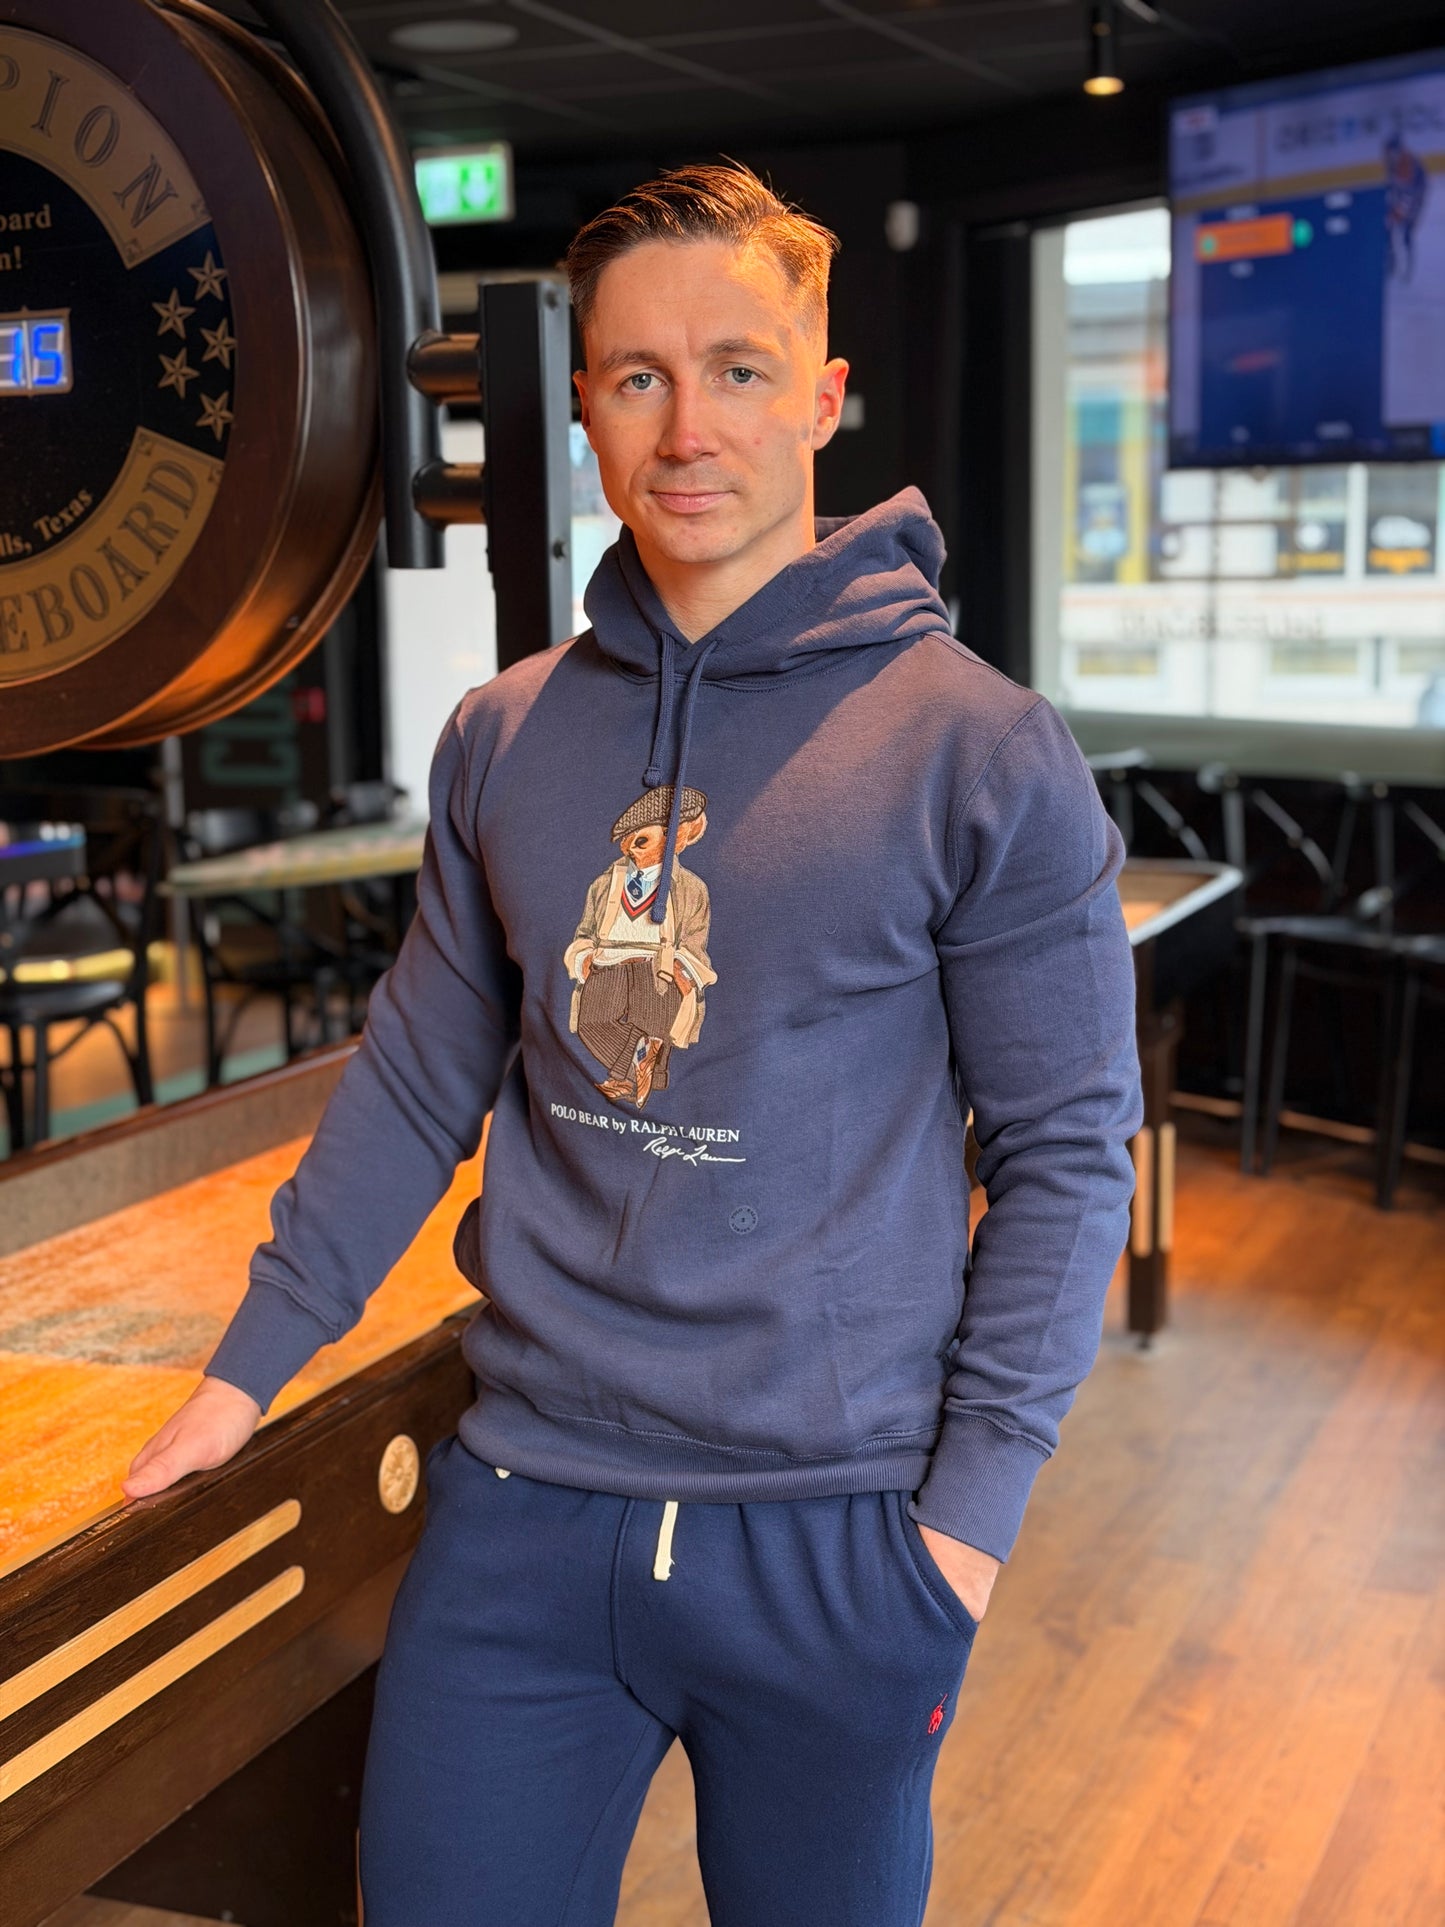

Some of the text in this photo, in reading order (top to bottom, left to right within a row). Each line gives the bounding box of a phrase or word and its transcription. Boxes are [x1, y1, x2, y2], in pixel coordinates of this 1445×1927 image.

[33, 489, 92, 541] Texas
[551, 1103, 740, 1142] POLO BEAR by RALPH LAUREN
